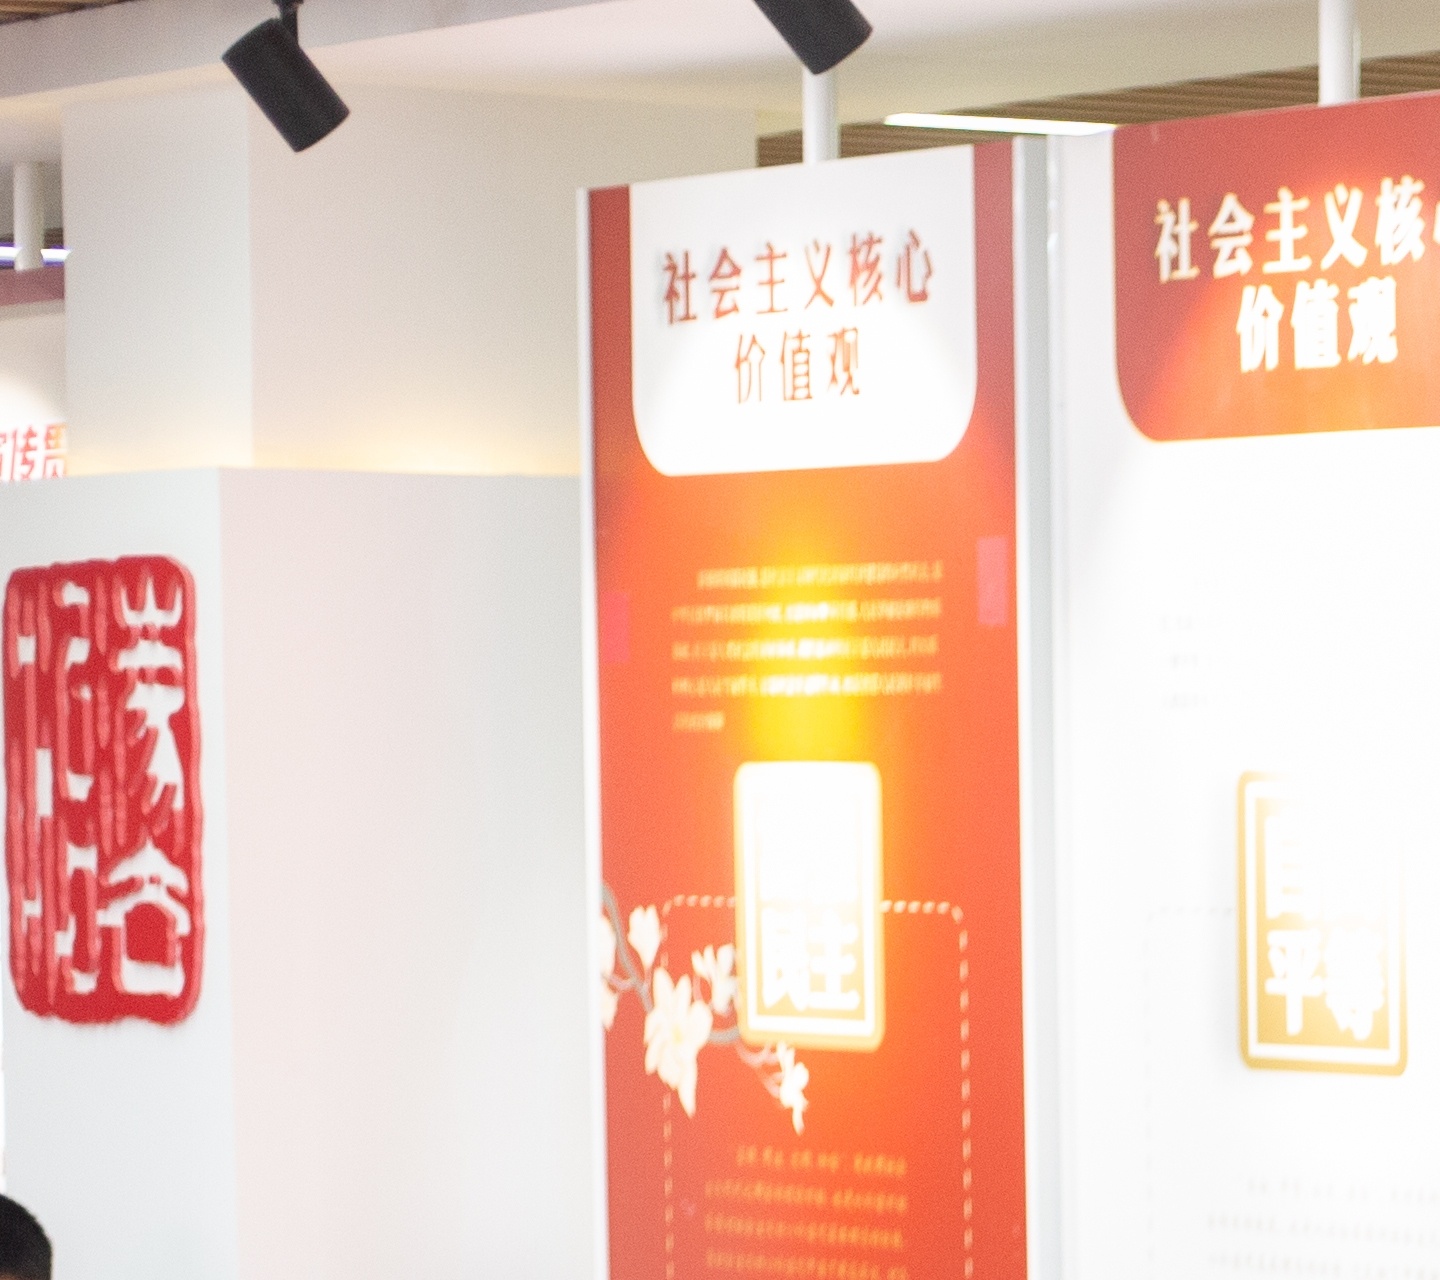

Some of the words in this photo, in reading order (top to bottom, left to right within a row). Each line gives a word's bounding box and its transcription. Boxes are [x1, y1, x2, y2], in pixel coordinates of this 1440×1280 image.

[662, 228, 935, 327] 社会主义核心
[1235, 275, 1399, 372] 价值观
[733, 332, 861, 405] 价值观
